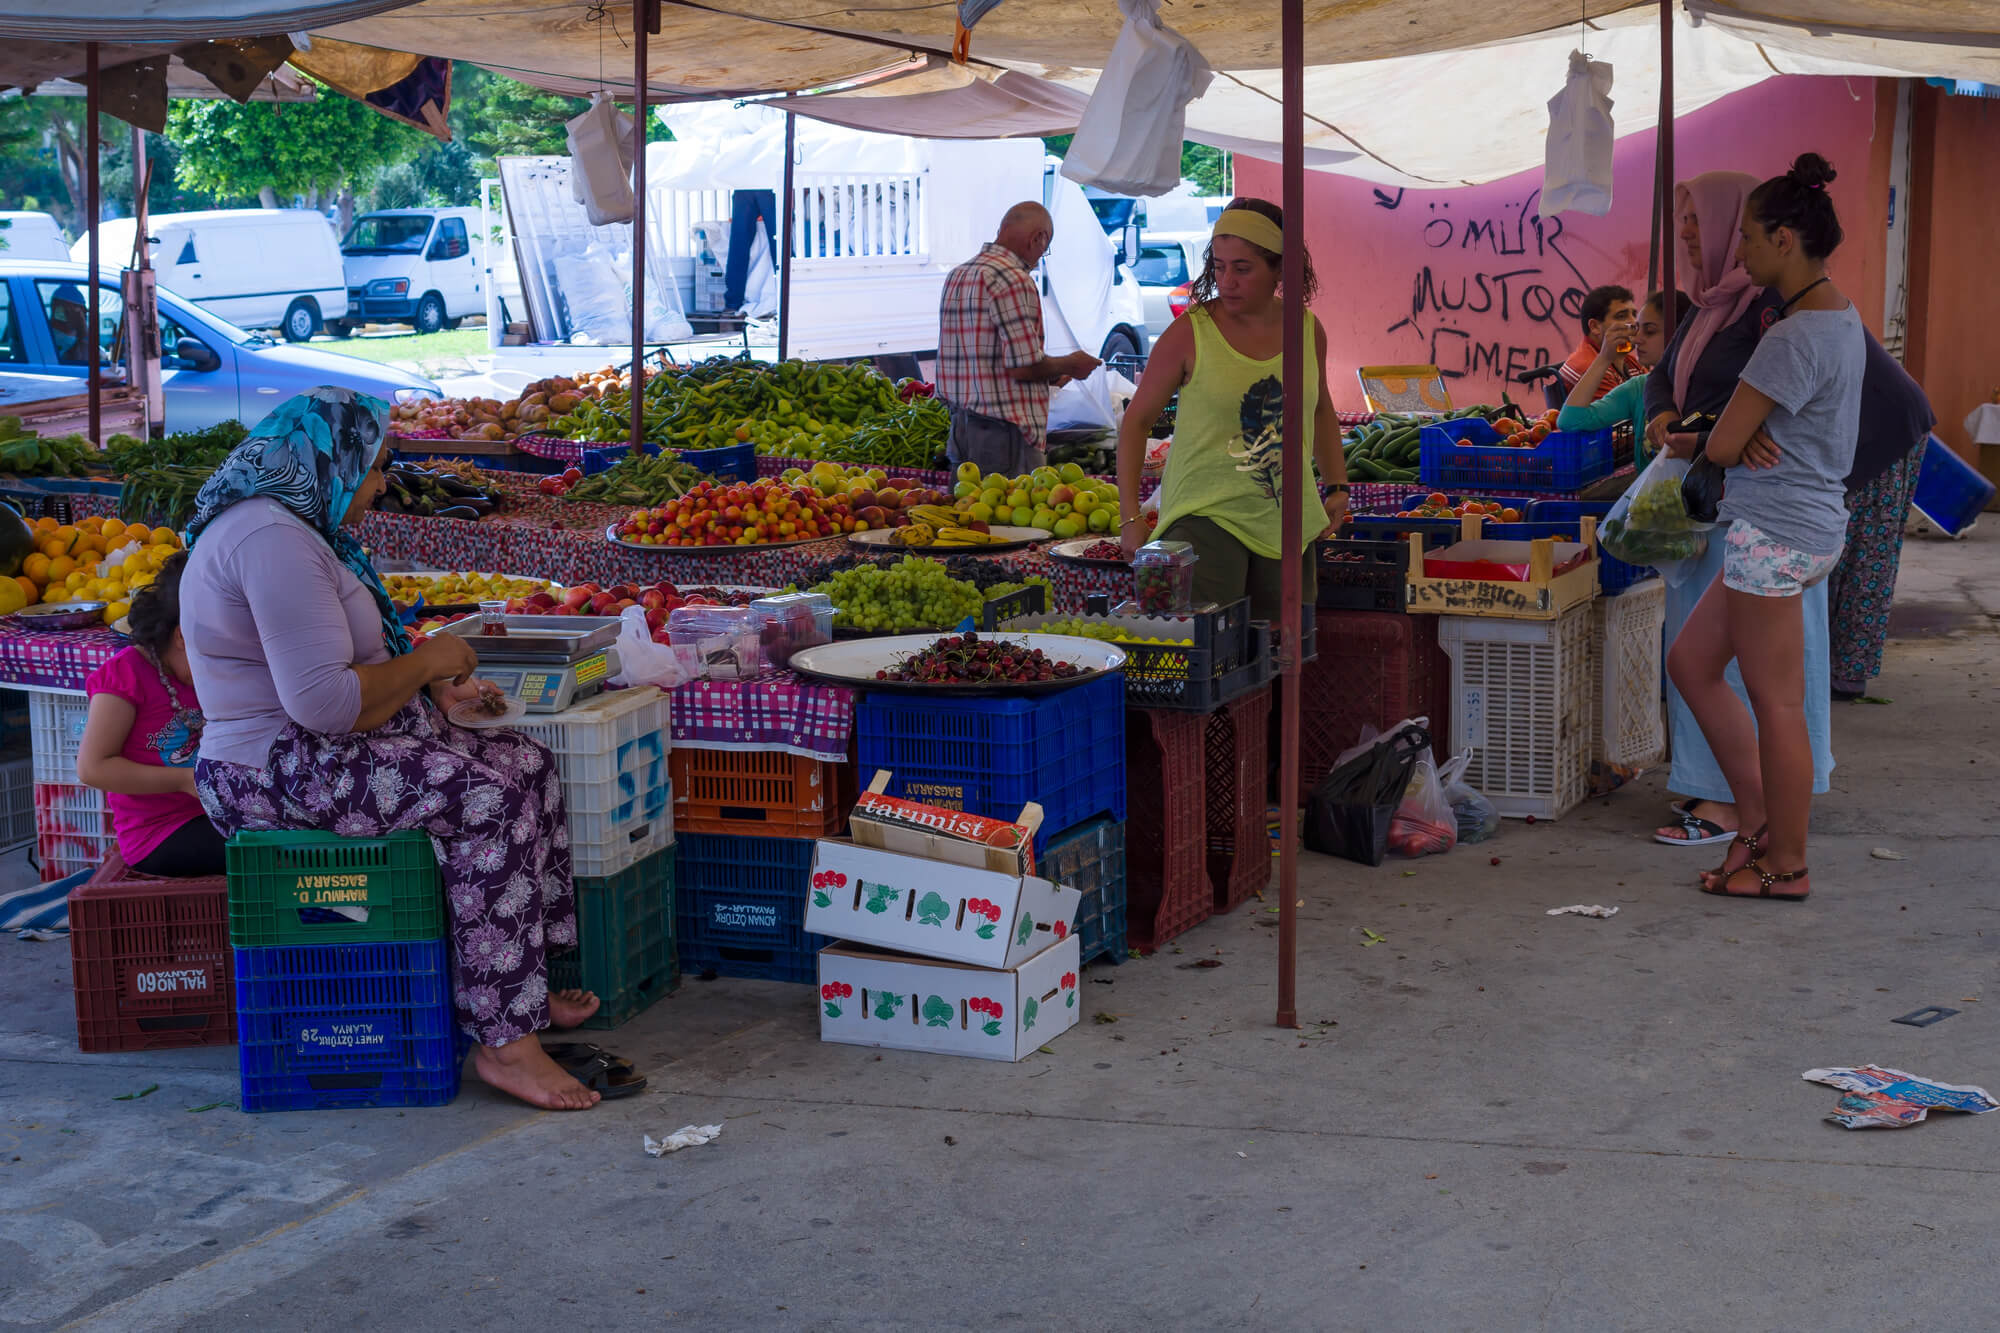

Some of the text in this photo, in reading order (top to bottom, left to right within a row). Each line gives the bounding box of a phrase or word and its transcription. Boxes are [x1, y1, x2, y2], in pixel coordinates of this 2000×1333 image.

[1424, 189, 1582, 272] ÖMÜR
[296, 874, 368, 889] BAGSARAY
[292, 888, 368, 903] MAHMUT D.
[748, 914, 777, 927] ADNAN
[156, 968, 205, 978] ALANYA
[137, 972, 207, 993] HAL NO 60
[331, 1023, 373, 1035] ALANYA
[318, 1034, 355, 1048] ÖZTÜRK
[354, 1034, 384, 1045] AHMET
